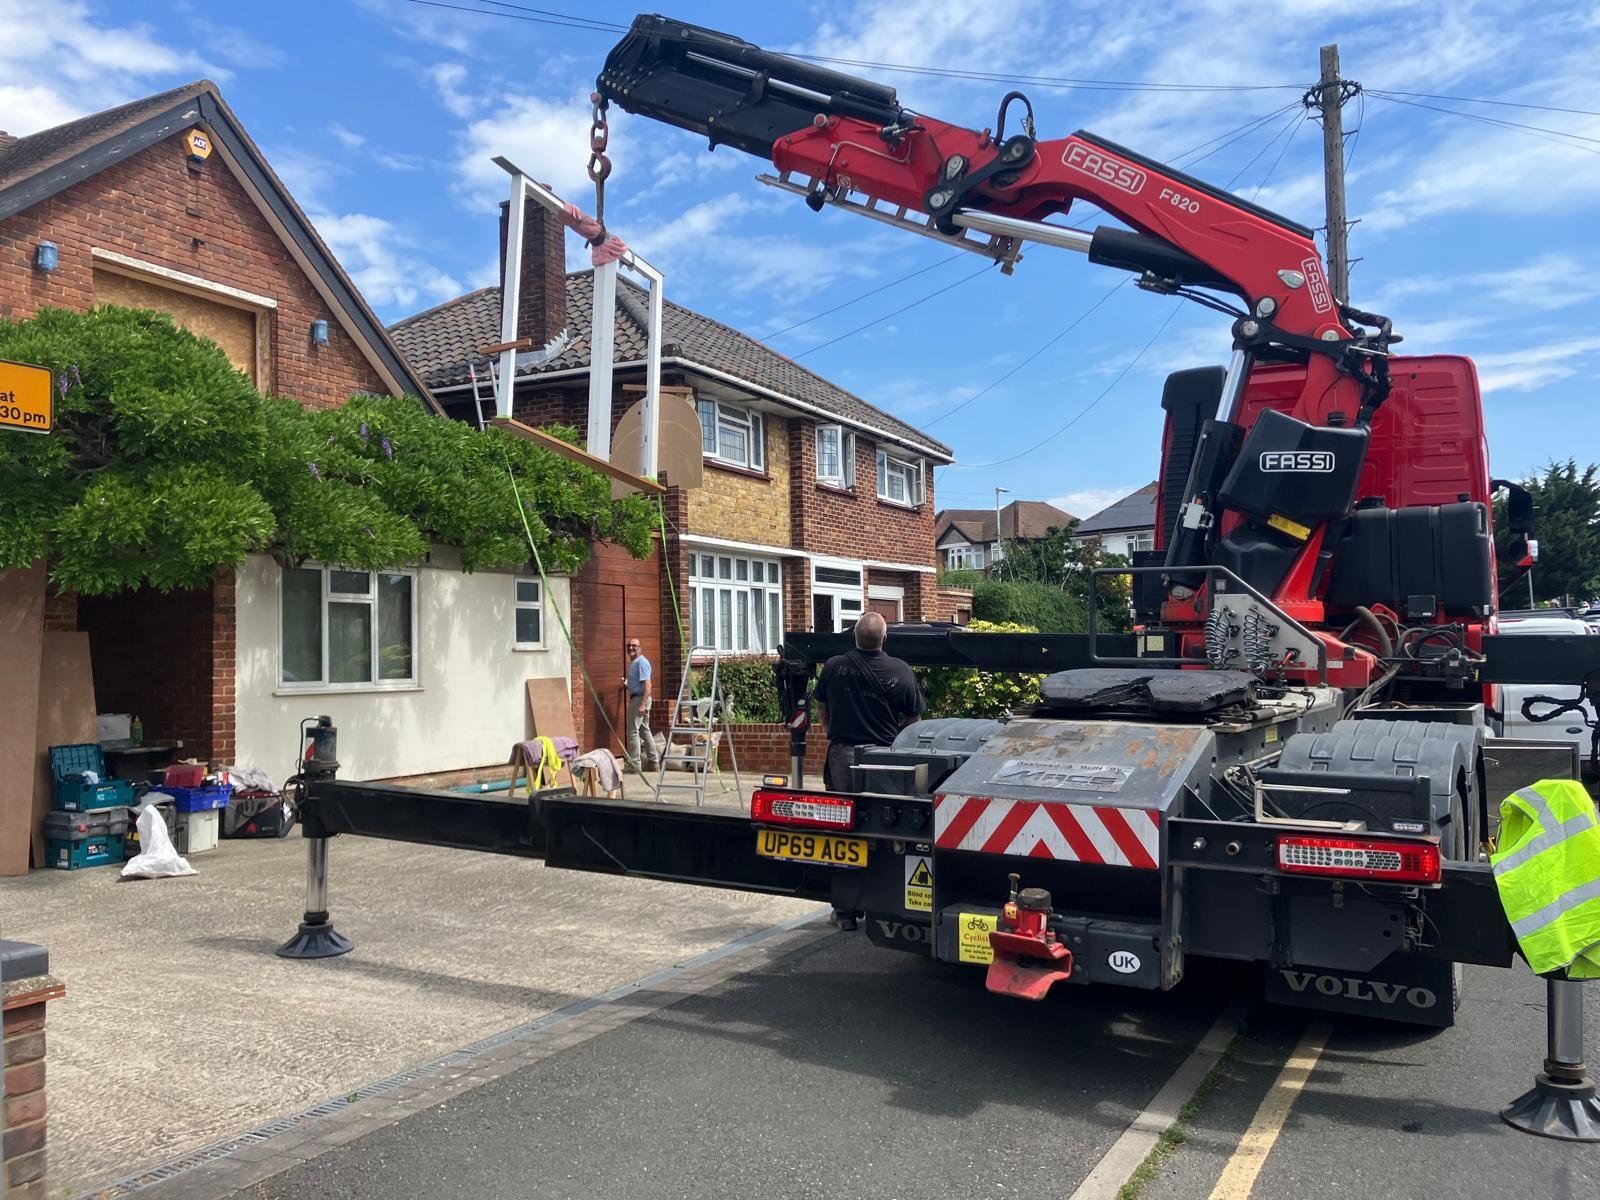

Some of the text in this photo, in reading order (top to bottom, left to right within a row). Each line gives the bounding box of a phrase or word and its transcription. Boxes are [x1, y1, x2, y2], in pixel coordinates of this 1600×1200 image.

[1067, 146, 1141, 190] FASSI
[1159, 188, 1200, 214] F820
[1305, 262, 1329, 309] FASSI
[0, 390, 15, 403] at
[0, 405, 46, 424] 30 pm
[1265, 454, 1330, 470] FASSI
[764, 832, 860, 863] UP69 AGS
[907, 890, 923, 898] Blind
[908, 898, 922, 906] Take
[964, 933, 989, 943] Cyclist
[1113, 954, 1136, 969] UK
[1279, 969, 1437, 1008] VOLVO
